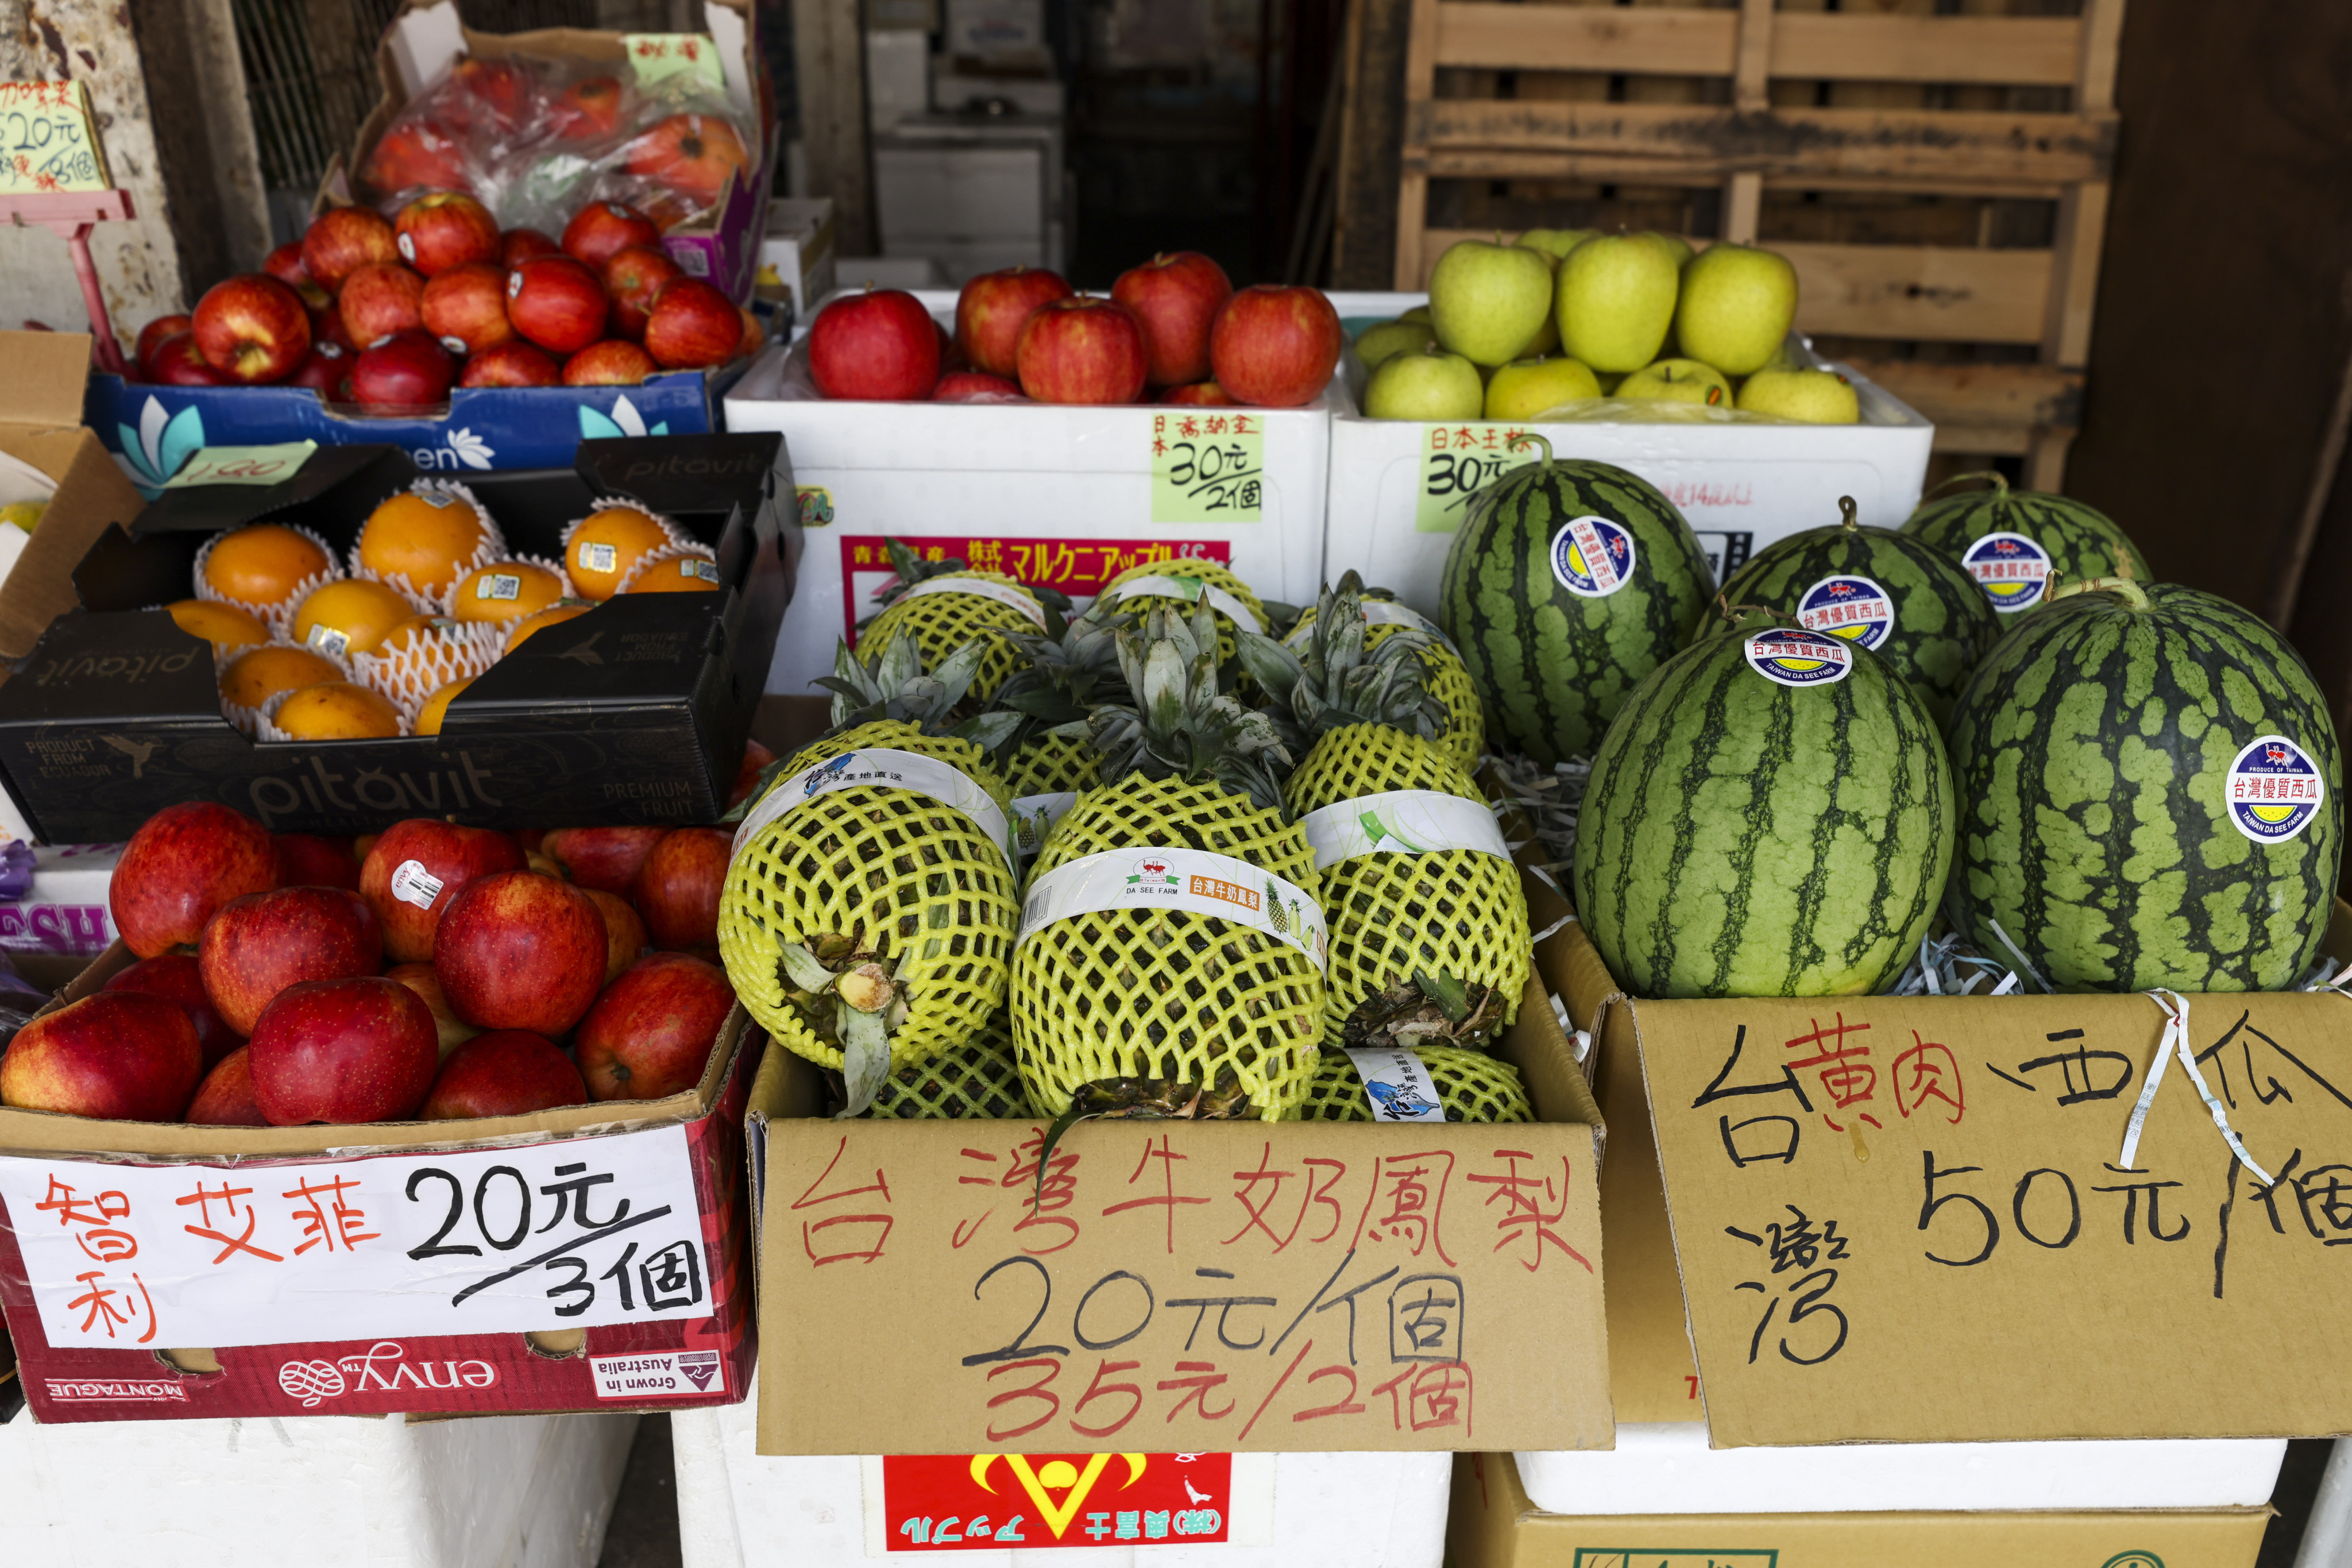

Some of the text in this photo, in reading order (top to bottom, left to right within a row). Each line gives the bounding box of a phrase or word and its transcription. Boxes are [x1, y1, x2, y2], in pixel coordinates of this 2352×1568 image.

[404, 447, 458, 470] en
[1803, 601, 1887, 628] 台灣優質西瓜
[1753, 642, 1845, 663] 台灣優質西瓜
[37, 646, 201, 686] pitavit
[1766, 662, 1792, 678] TAIWAN
[1819, 666, 1836, 677] FARM
[25, 739, 96, 755] PRODUCT
[41, 752, 87, 766] FROM
[39, 764, 112, 779] ECUADOR
[843, 771, 903, 782] 產地直送
[249, 750, 504, 829] pitavit
[603, 781, 692, 799] PREMIUM
[2234, 777, 2318, 799] 台灣優質西瓜
[640, 800, 694, 817] FRUIT
[2242, 810, 2265, 832] TAIWAN
[2264, 825, 2274, 833] DA
[2287, 810, 2304, 829] FARM
[1193, 877, 1258, 909] 台灣牛奶鳳梨
[790, 1127, 1594, 1275] 台灣牛奶鳳梨
[175, 1175, 383, 1265] 艾菲
[35, 1173, 157, 1343] 智利
[962, 1249, 1463, 1367] 20元/個
[352, 1341, 495, 1392] envy
[598, 1358, 672, 1375] Australia
[46, 1382, 184, 1397] MONTAGUE
[605, 1377, 676, 1392] Grown in
[986, 1339, 1473, 1442] 35元/2個
[900, 1514, 1025, 1544] アップル
